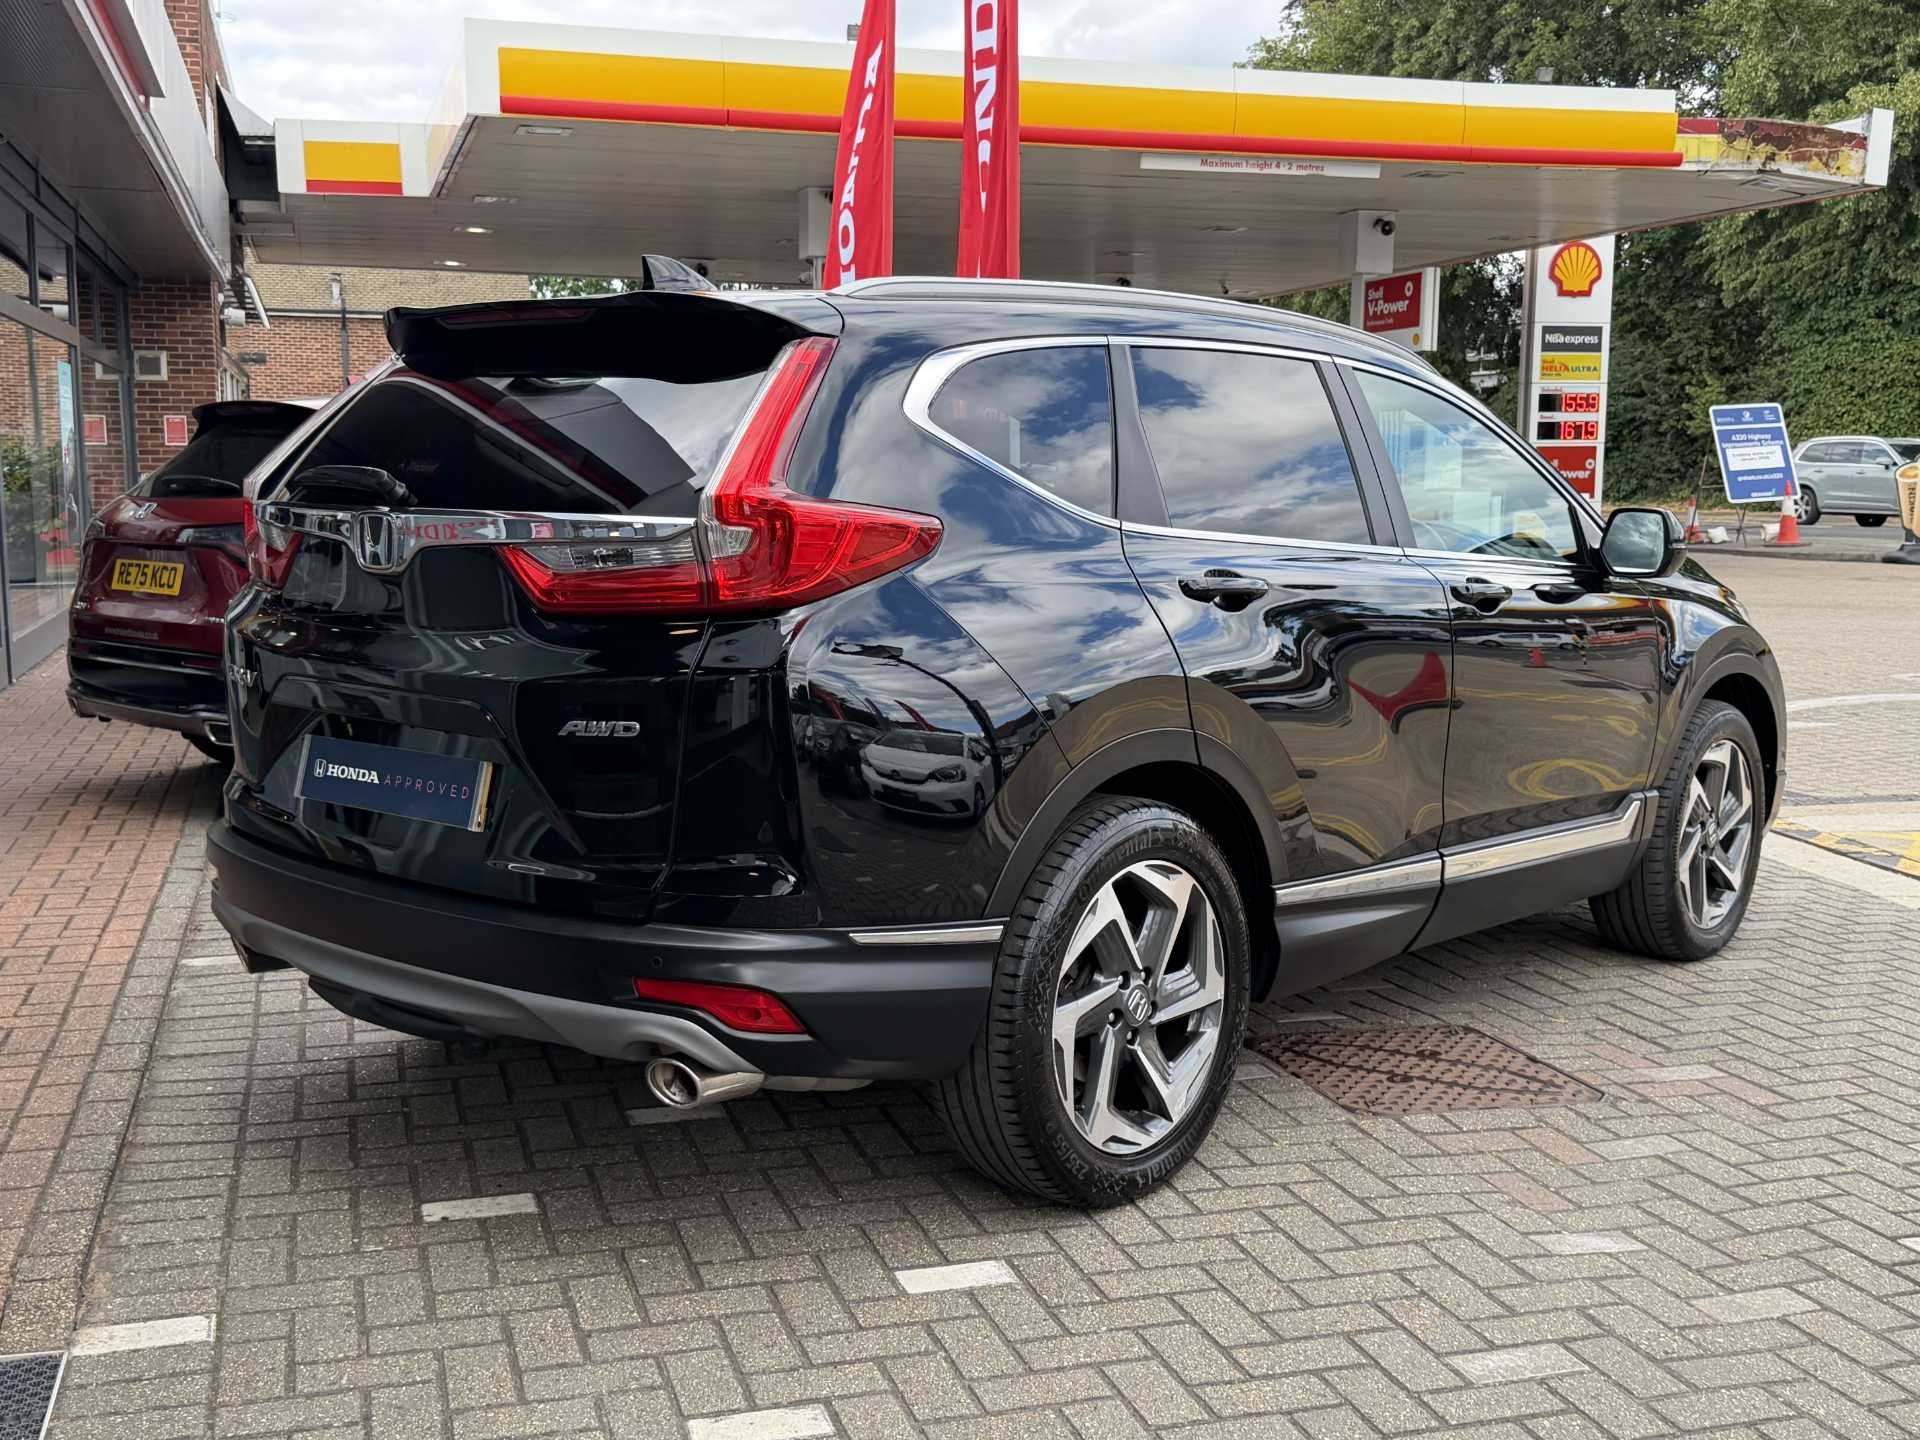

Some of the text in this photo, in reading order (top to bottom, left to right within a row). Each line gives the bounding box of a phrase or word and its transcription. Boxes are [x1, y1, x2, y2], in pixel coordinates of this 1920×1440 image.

[1200, 157, 1243, 169] Maximum
[1296, 163, 1325, 173] metres
[1368, 286, 1384, 300] Shell
[1368, 300, 1410, 317] V-Power
[1545, 333, 1600, 345] Nisa express
[1561, 393, 1599, 412] 155.9
[1560, 421, 1597, 440] 167.9
[116, 562, 178, 590] RE75 KCO
[557, 720, 641, 737] AWD
[326, 763, 470, 799] HONDA APPROVED
